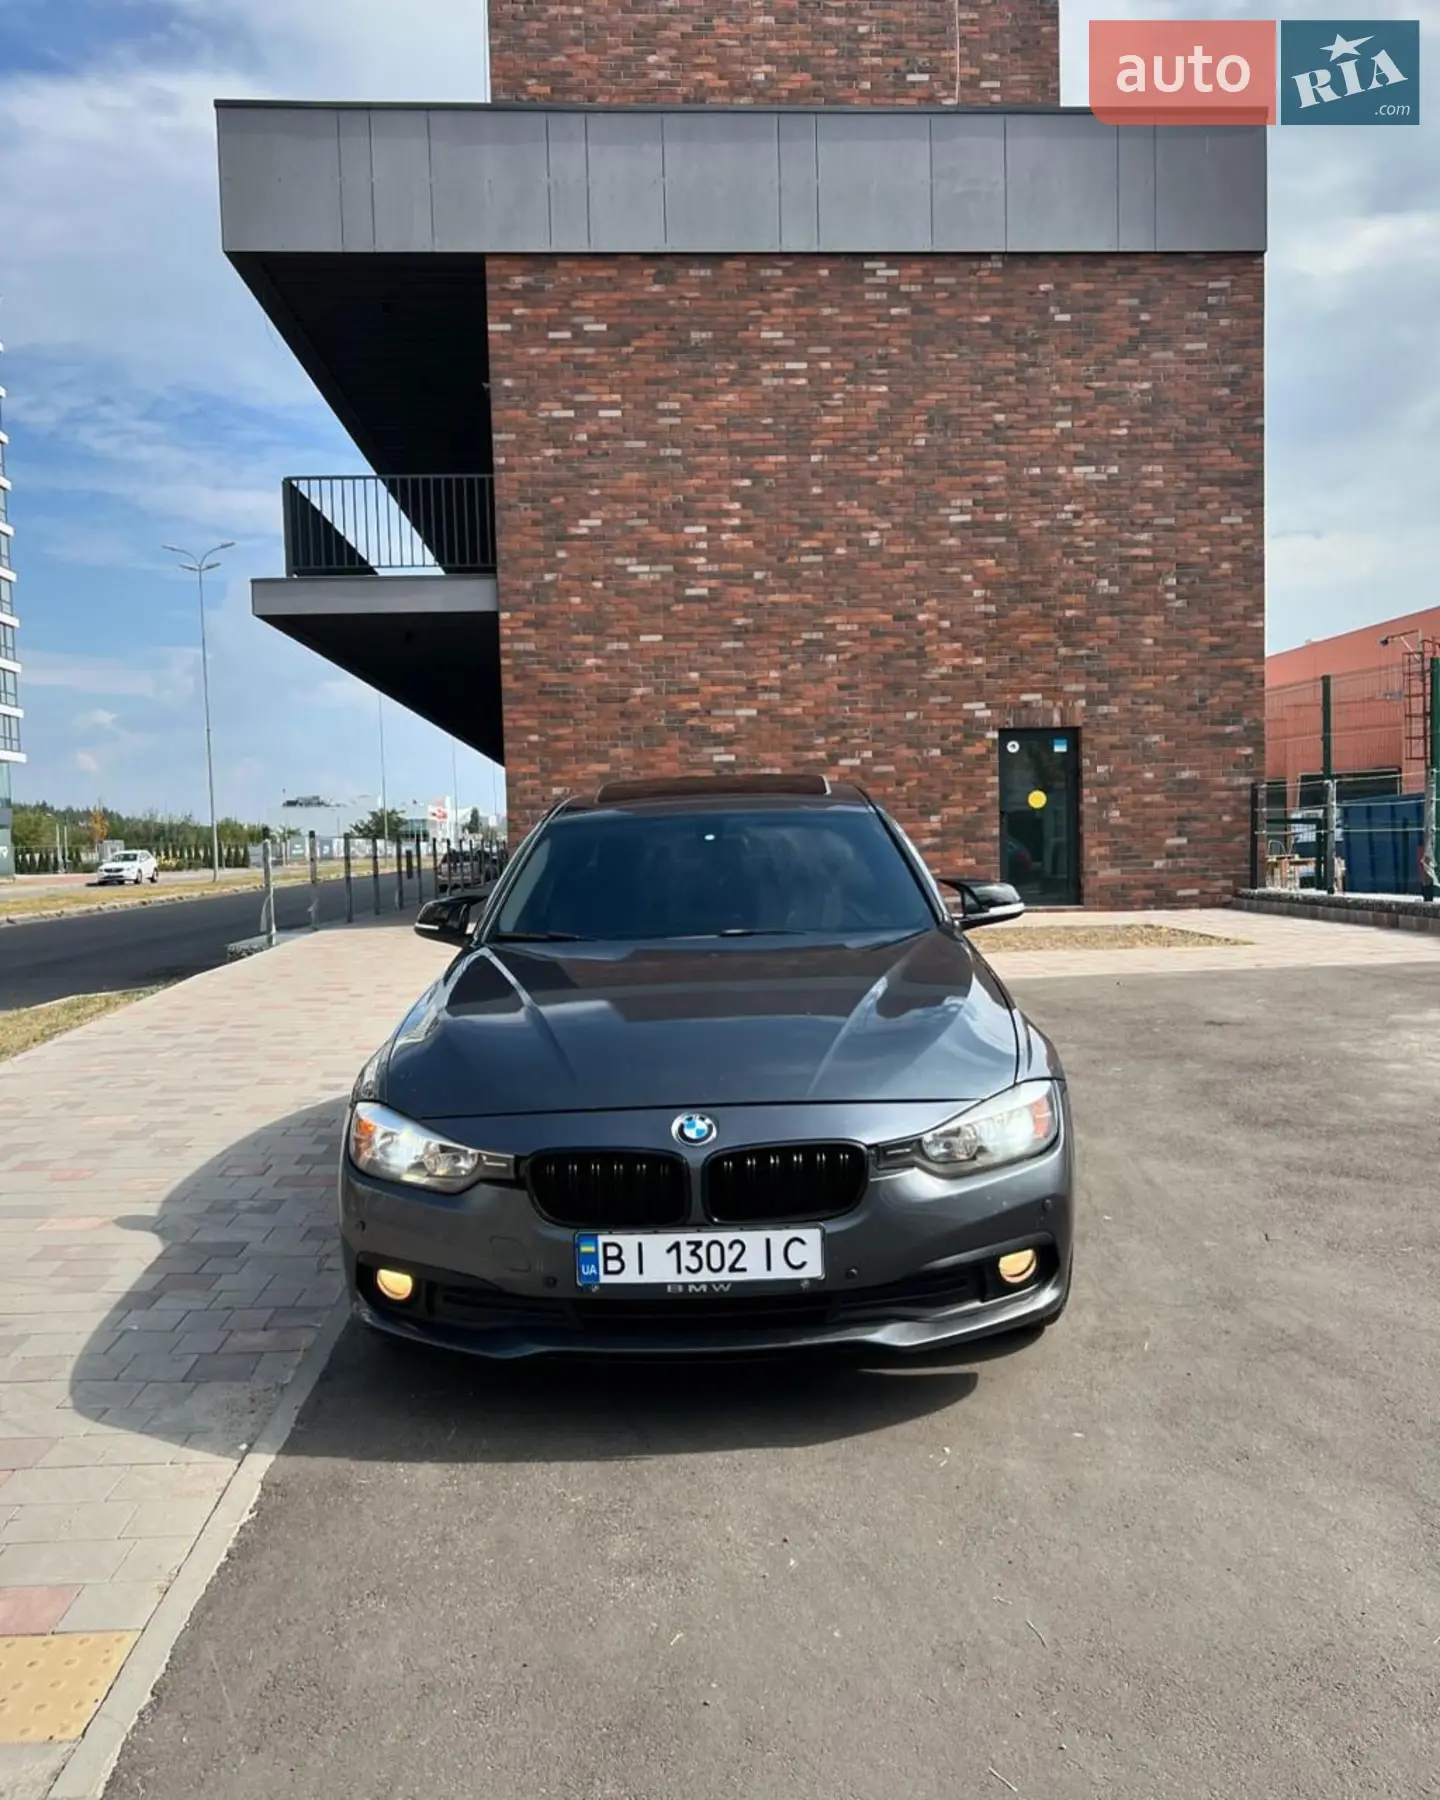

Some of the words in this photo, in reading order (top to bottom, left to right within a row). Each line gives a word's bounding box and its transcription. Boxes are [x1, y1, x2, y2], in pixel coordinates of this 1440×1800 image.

[602, 1241, 644, 1276] BI
[665, 1238, 748, 1275] 1302
[765, 1236, 808, 1272] IC
[581, 1264, 597, 1276] UA
[666, 1283, 732, 1293] BMW
